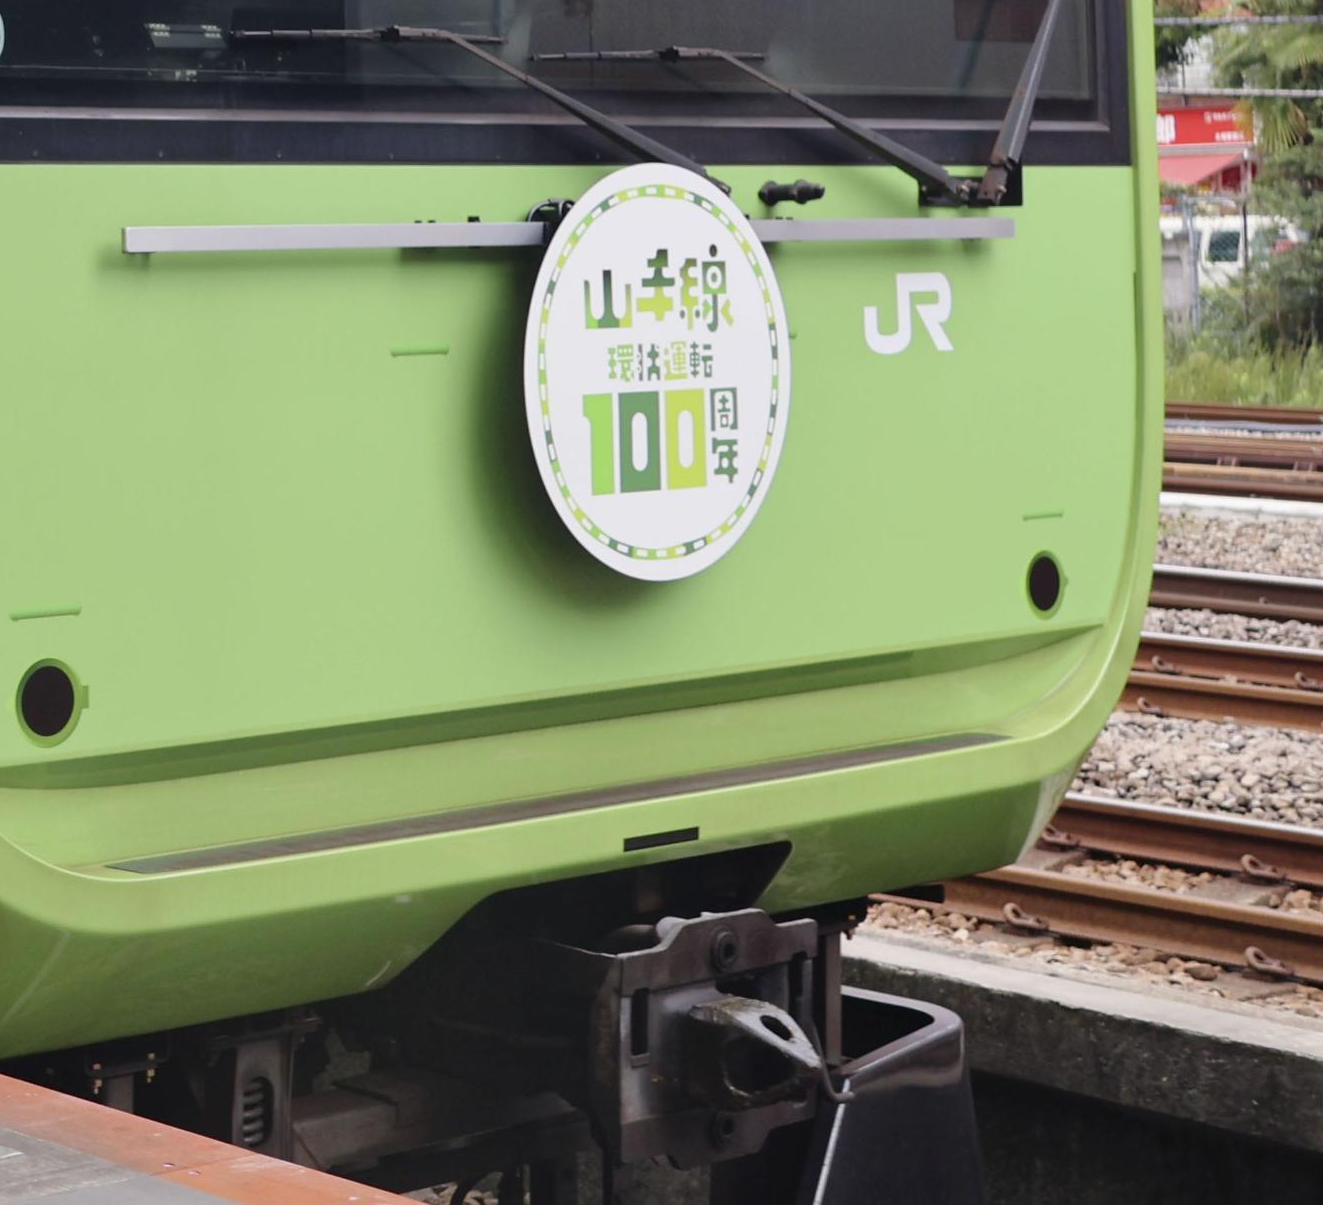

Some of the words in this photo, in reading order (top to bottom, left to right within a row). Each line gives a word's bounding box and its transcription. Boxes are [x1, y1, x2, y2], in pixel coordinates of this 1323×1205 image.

[584, 243, 734, 332] 山手線
[863, 272, 954, 355] JR
[607, 340, 713, 382] 環状運転
